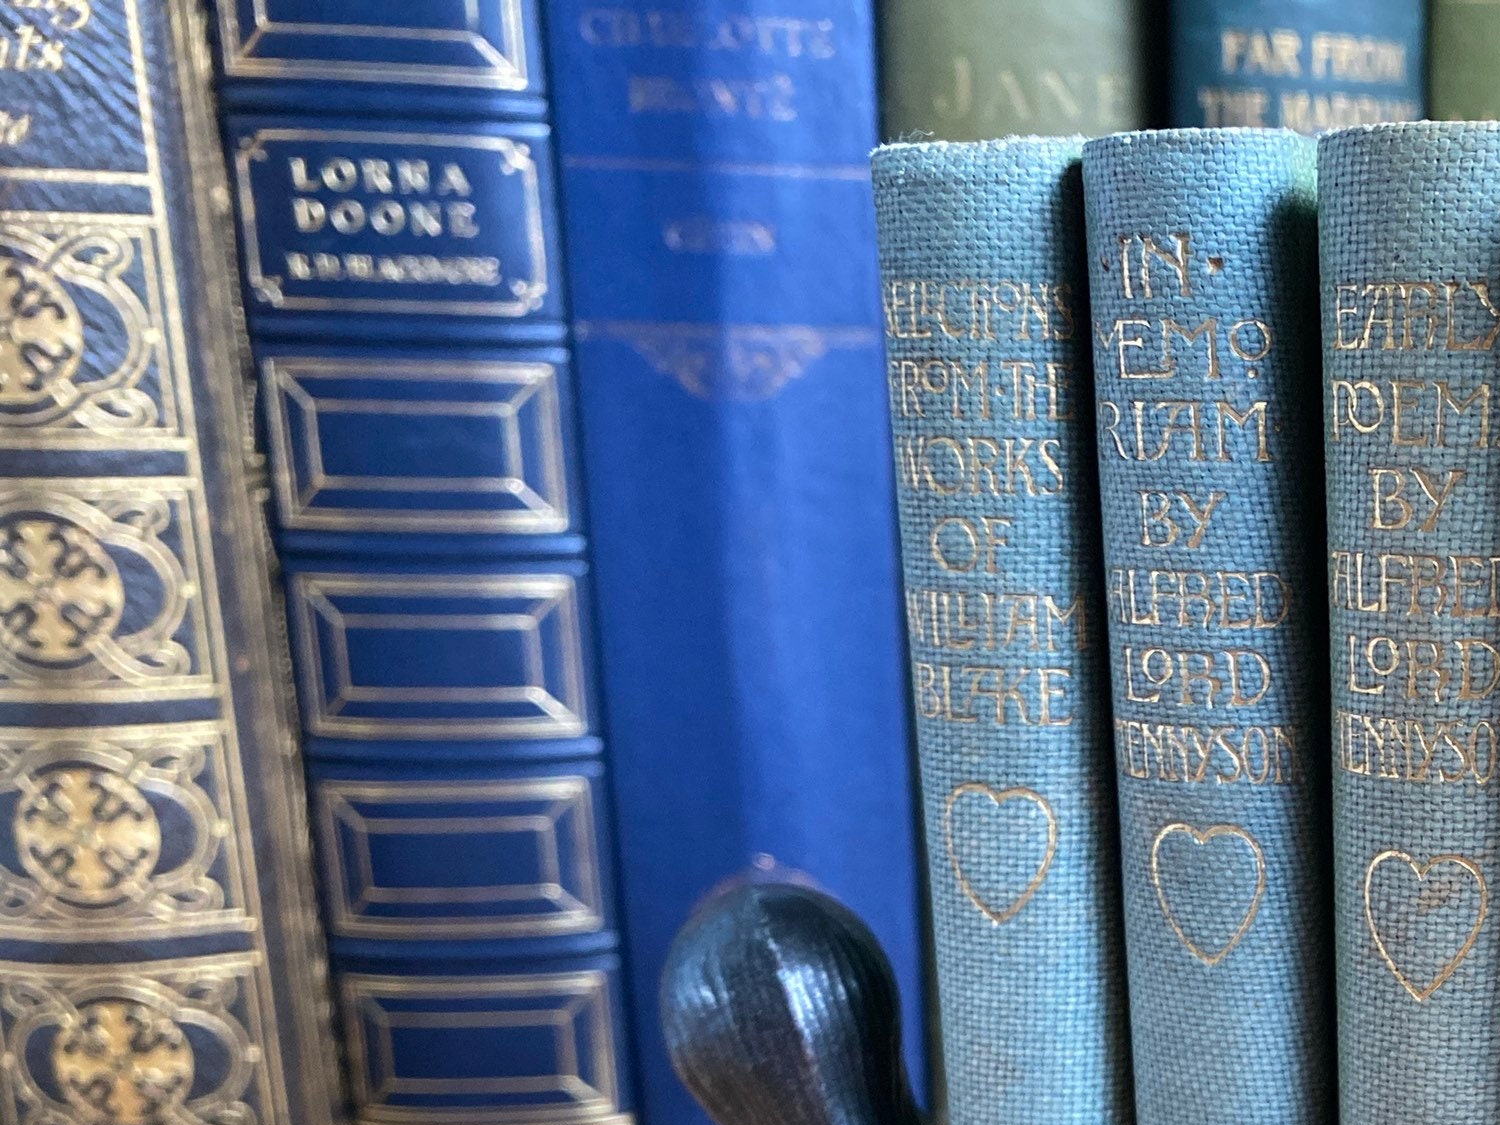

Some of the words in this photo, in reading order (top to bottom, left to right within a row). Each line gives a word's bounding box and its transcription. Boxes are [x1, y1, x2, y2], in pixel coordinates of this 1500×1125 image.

[1222, 28, 1302, 77] FAR
[288, 156, 473, 197] LORNA
[291, 197, 480, 238] DOONE
[1118, 234, 1191, 299] IN
[899, 435, 1064, 497] WORKS
[1135, 488, 1228, 549] BY
[1368, 466, 1467, 532] BY
[929, 516, 1014, 574] OF
[915, 661, 1074, 727] BLAKE
[1123, 645, 1272, 710] LORD
